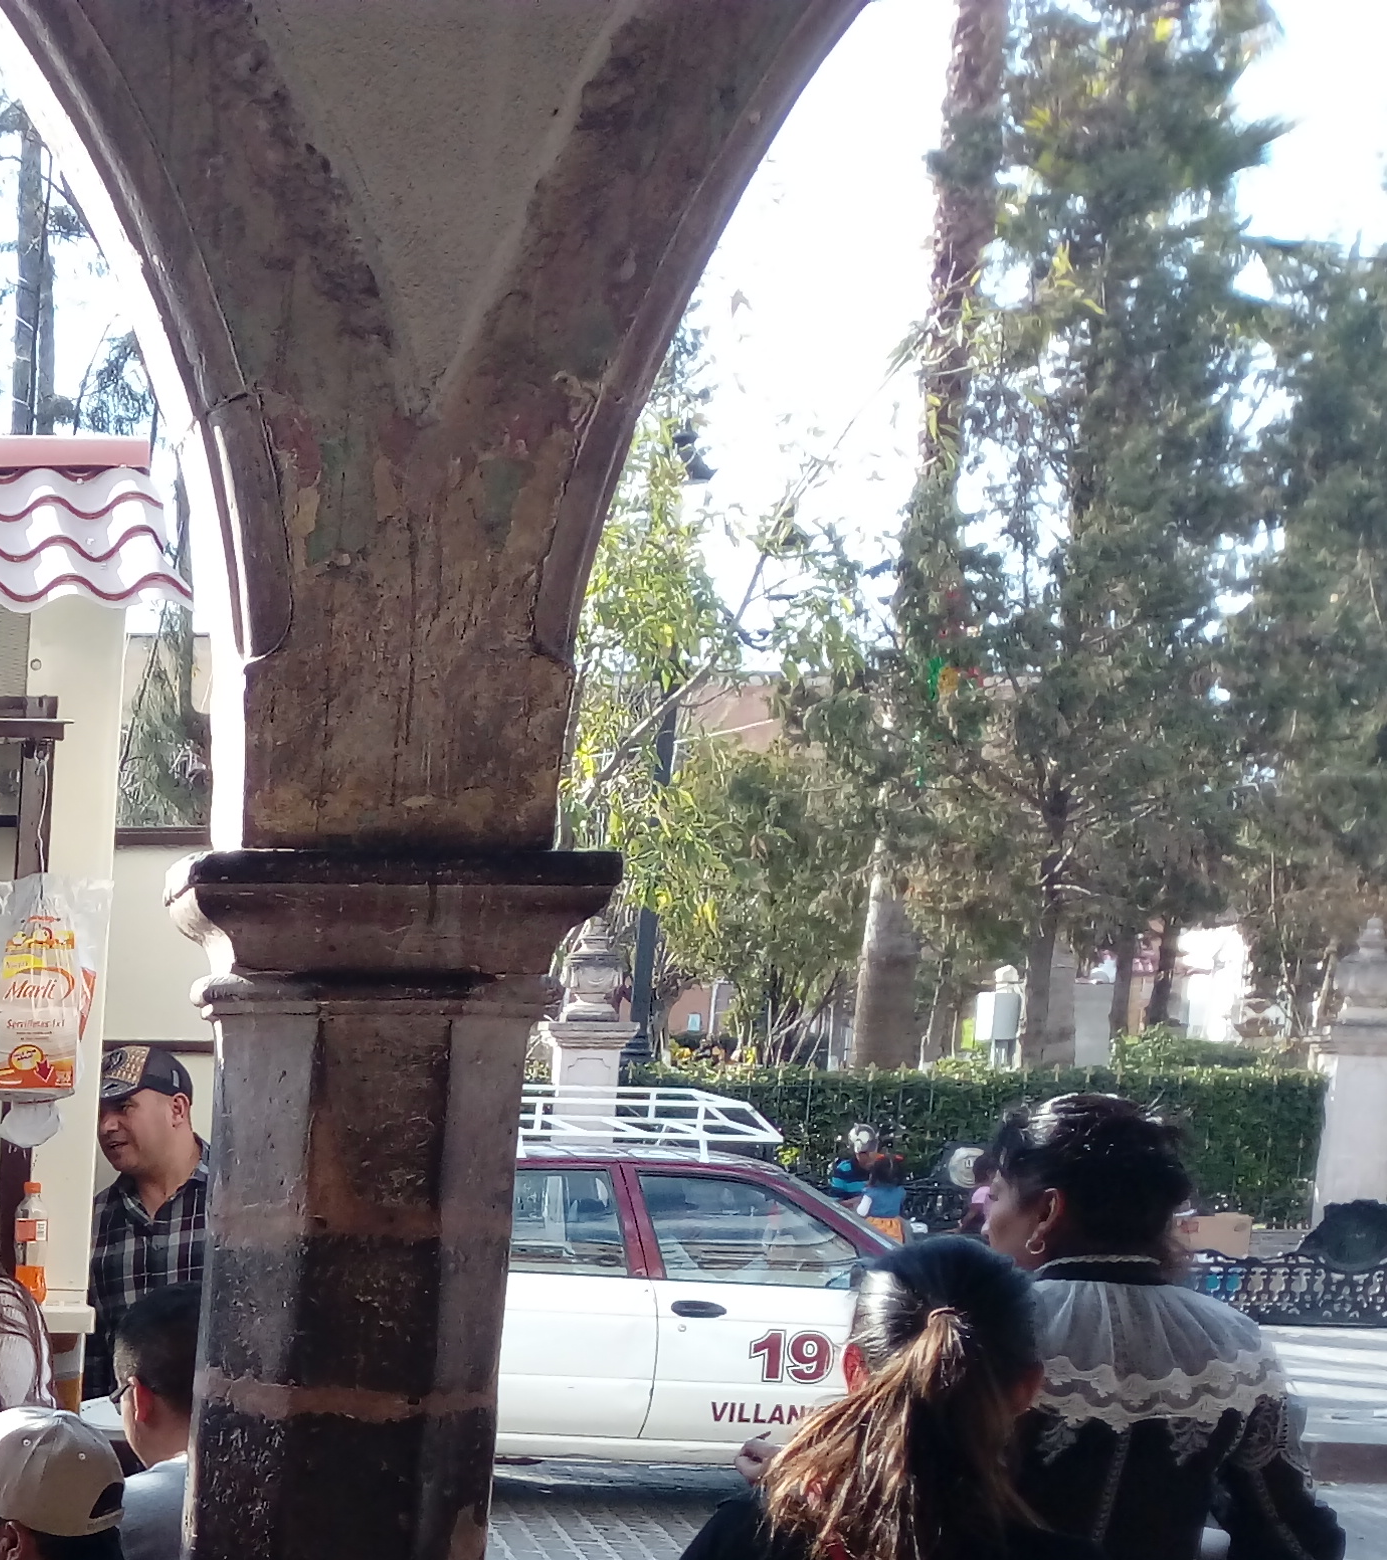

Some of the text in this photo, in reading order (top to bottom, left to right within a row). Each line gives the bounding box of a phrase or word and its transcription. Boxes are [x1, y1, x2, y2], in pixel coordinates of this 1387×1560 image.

[4, 979, 58, 1001] Marli
[748, 1328, 835, 1385] 19
[711, 1401, 806, 1425] VILLAN
